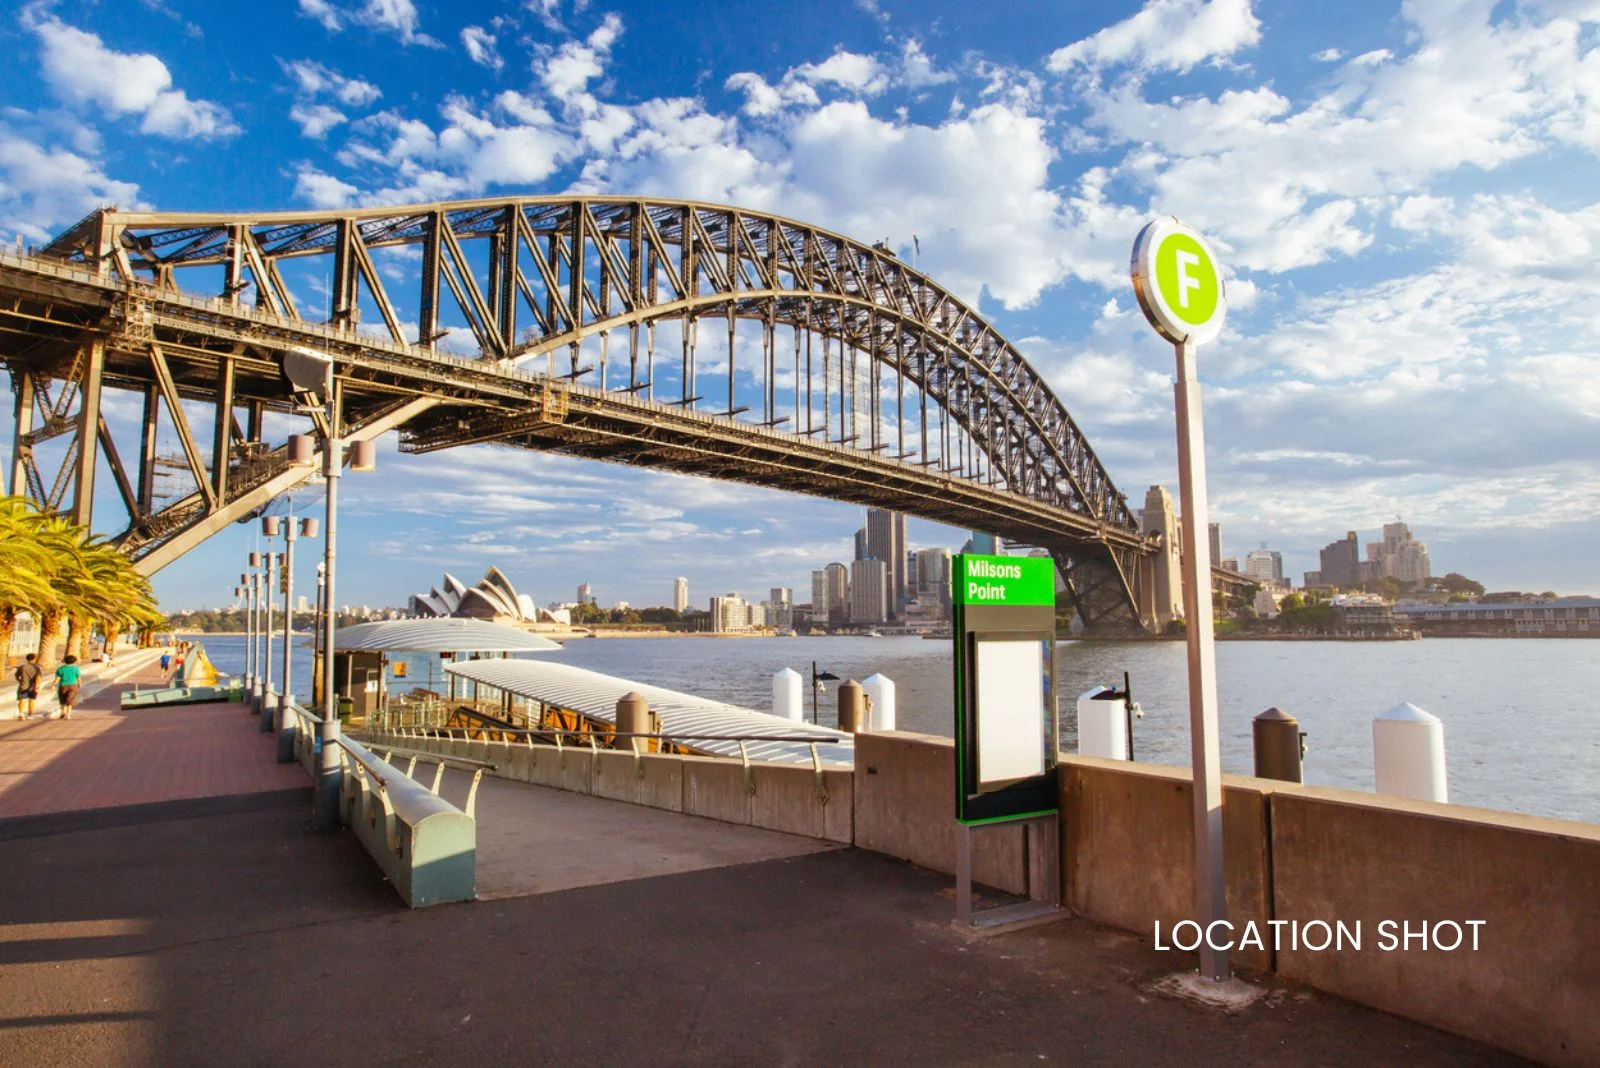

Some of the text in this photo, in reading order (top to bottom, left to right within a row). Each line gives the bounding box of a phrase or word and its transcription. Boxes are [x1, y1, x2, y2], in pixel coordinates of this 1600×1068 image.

[1176, 250, 1200, 308] F
[967, 560, 1022, 578] Milsons
[967, 582, 1006, 600] Point
